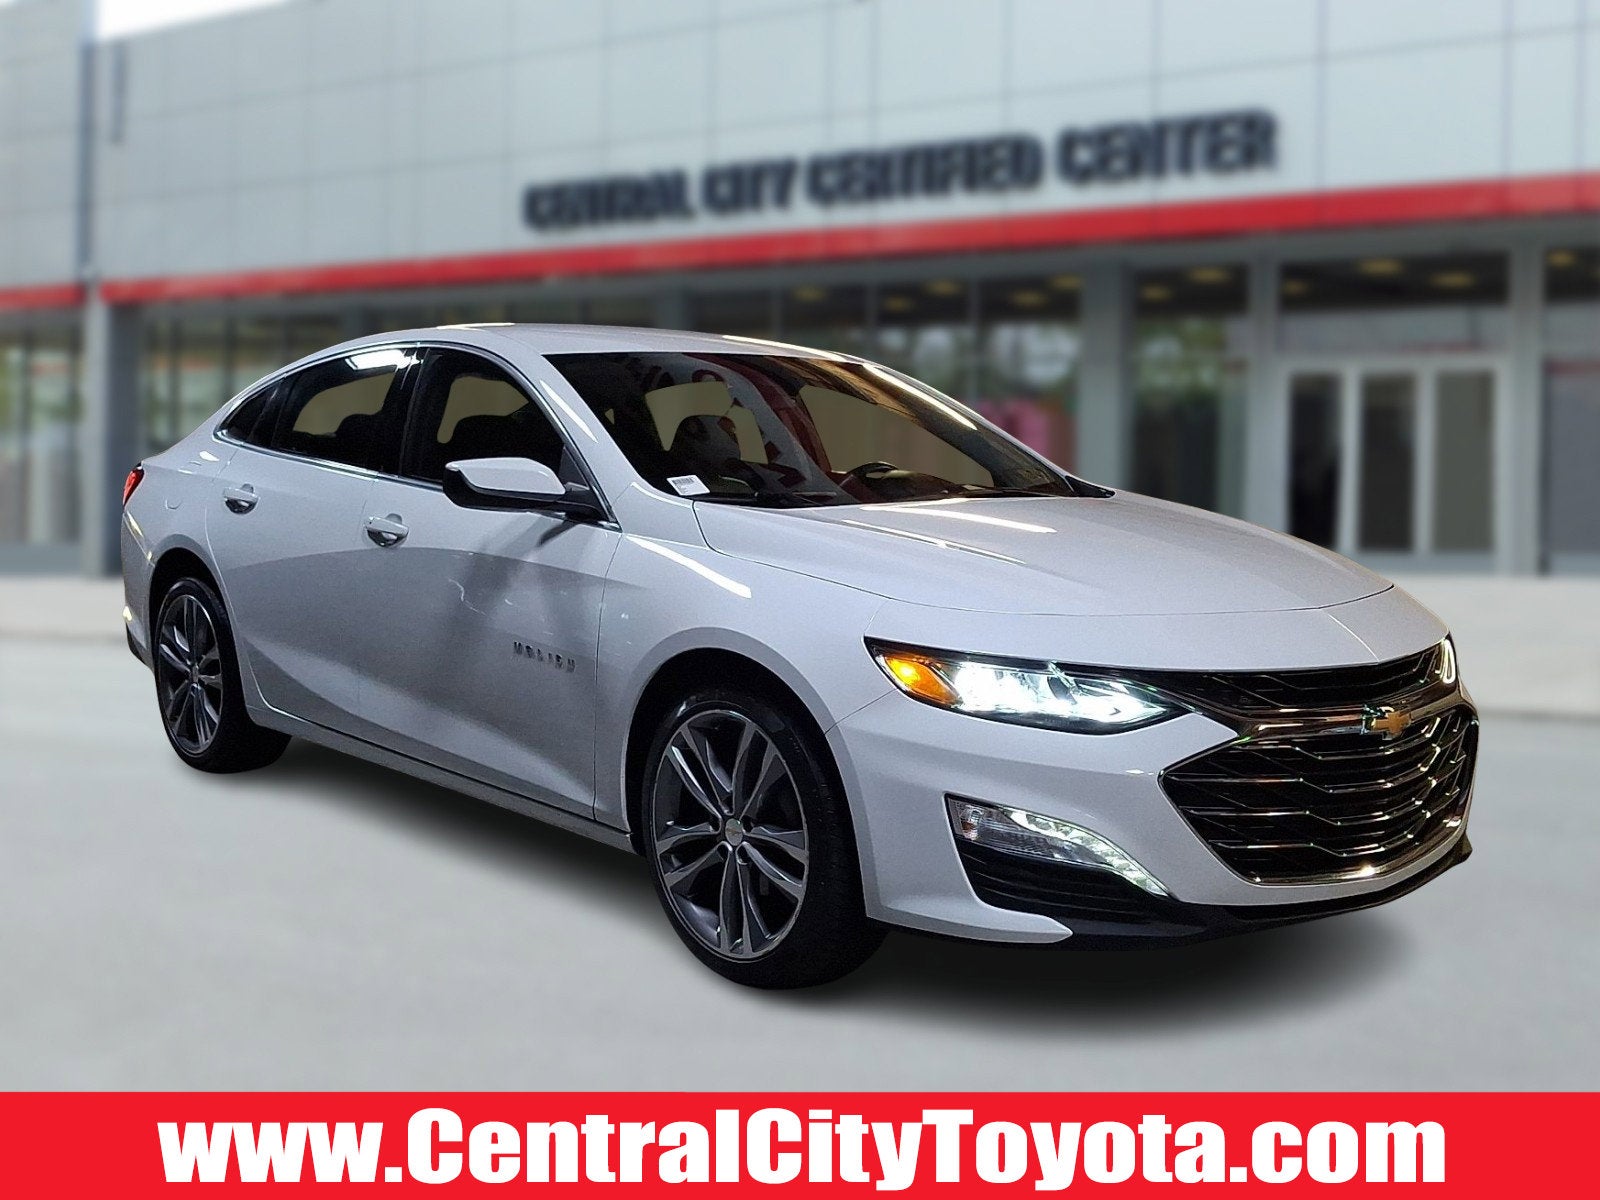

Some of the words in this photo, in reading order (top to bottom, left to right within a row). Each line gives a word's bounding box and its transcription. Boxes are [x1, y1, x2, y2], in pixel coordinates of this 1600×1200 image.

[523, 171, 696, 233] CENTRAL
[701, 159, 797, 217] CITY
[805, 138, 1045, 207] CERTIFIED
[1056, 112, 1277, 186] CENTER
